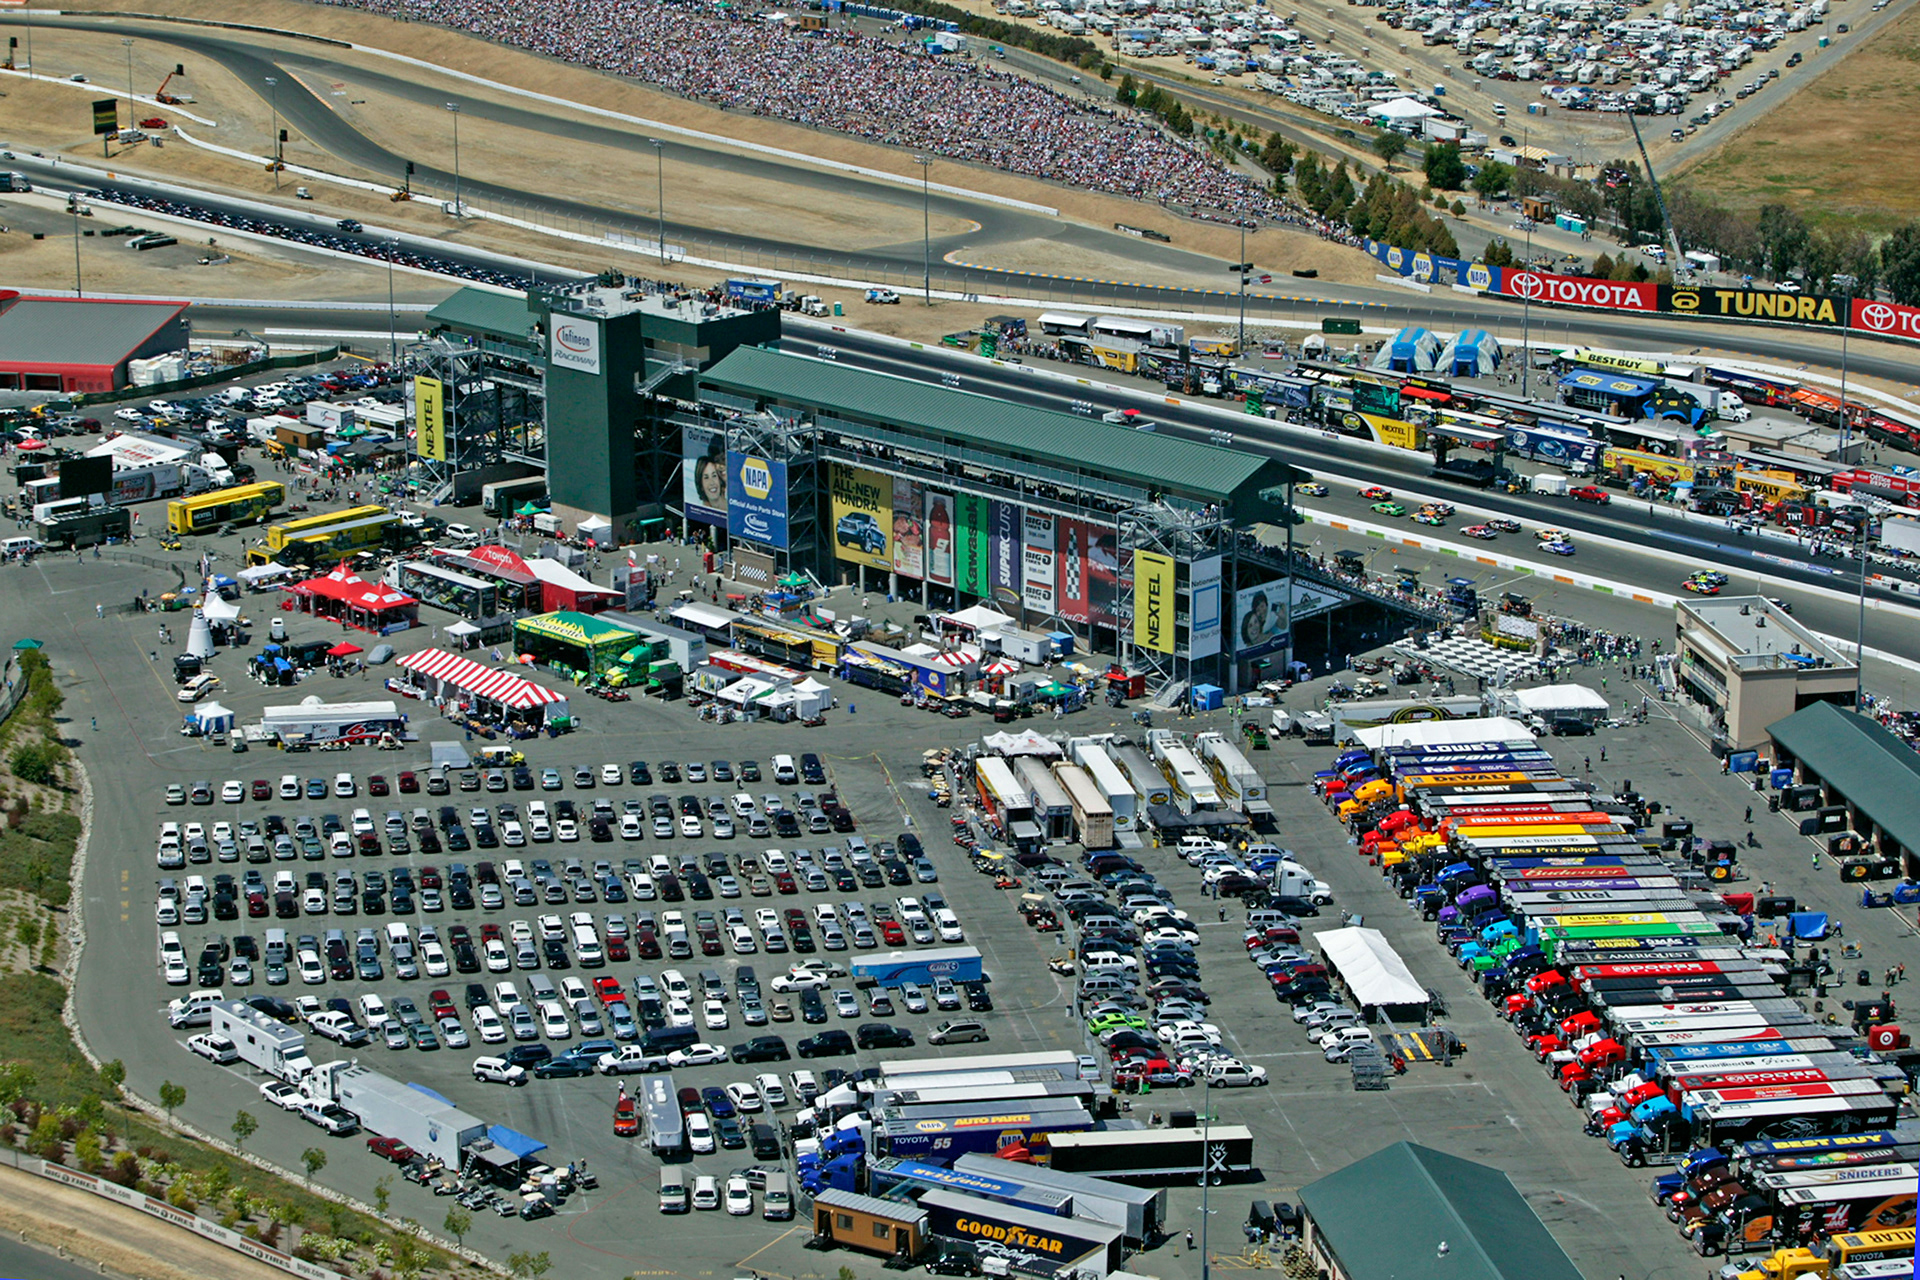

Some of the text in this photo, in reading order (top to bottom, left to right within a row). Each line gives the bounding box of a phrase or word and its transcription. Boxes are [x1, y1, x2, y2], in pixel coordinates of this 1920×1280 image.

[1390, 252, 1401, 263] NAPA
[1415, 258, 1430, 273] NAPA
[1470, 270, 1488, 284] NAPA
[1546, 279, 1643, 306] TOYOTA
[1715, 290, 1837, 322] TUNDRA
[562, 326, 590, 346] Infineon
[554, 350, 596, 366] RACEWAY
[1588, 354, 1642, 369] BEST BUY
[424, 395, 436, 456] NEXTEL
[1382, 424, 1406, 434] NEXTEL
[1581, 446, 1596, 460] 2
[746, 467, 768, 490] NAPA
[833, 464, 854, 480] THE
[1870, 473, 1891, 484] Office
[832, 478, 880, 500] ALL-NEW
[728, 498, 786, 518] Official Auto Parts Store
[833, 491, 881, 514] TUNDRA.
[748, 516, 768, 528] Infineon
[1026, 516, 1042, 526] BIG
[1786, 512, 1802, 520] TNT
[1000, 502, 1011, 588] SUPERCUTS
[488, 550, 514, 564] TOYOTA
[1026, 552, 1042, 560] BIG
[1026, 586, 1042, 596] BIG
[1148, 574, 1160, 647] NEXTEL
[532, 618, 584, 639] Nicorette
[346, 724, 366, 736] 6
[1422, 742, 1500, 753] LOWE'S
[1421, 753, 1509, 762] DUPONT
[1424, 765, 1475, 773] FedEx
[1524, 867, 1624, 877] Budweiser
[1608, 951, 1691, 960] AMERIQUEST
[1630, 964, 1703, 972] DODGE
[1687, 1062, 1746, 1070] CertainTeed
[1745, 1070, 1818, 1080] DODGE
[954, 1114, 1031, 1125] AUTO PARTS
[894, 1136, 930, 1144] TOYOTA
[932, 1138, 952, 1150] 55
[1772, 1135, 1882, 1150] BEST BUY
[44, 1168, 61, 1178] BIG
[70, 1178, 98, 1190] TIRES
[1838, 1168, 1900, 1180] SNICKERS
[144, 1203, 160, 1214] BIG
[169, 1214, 195, 1228] TIRES
[956, 1218, 1064, 1254] GOODYEAR
[239, 1242, 255, 1254] BIG
[264, 1254, 291, 1268] TIRES
[974, 1240, 1043, 1266] Racing
[1850, 1252, 1884, 1262] TOYOTA
